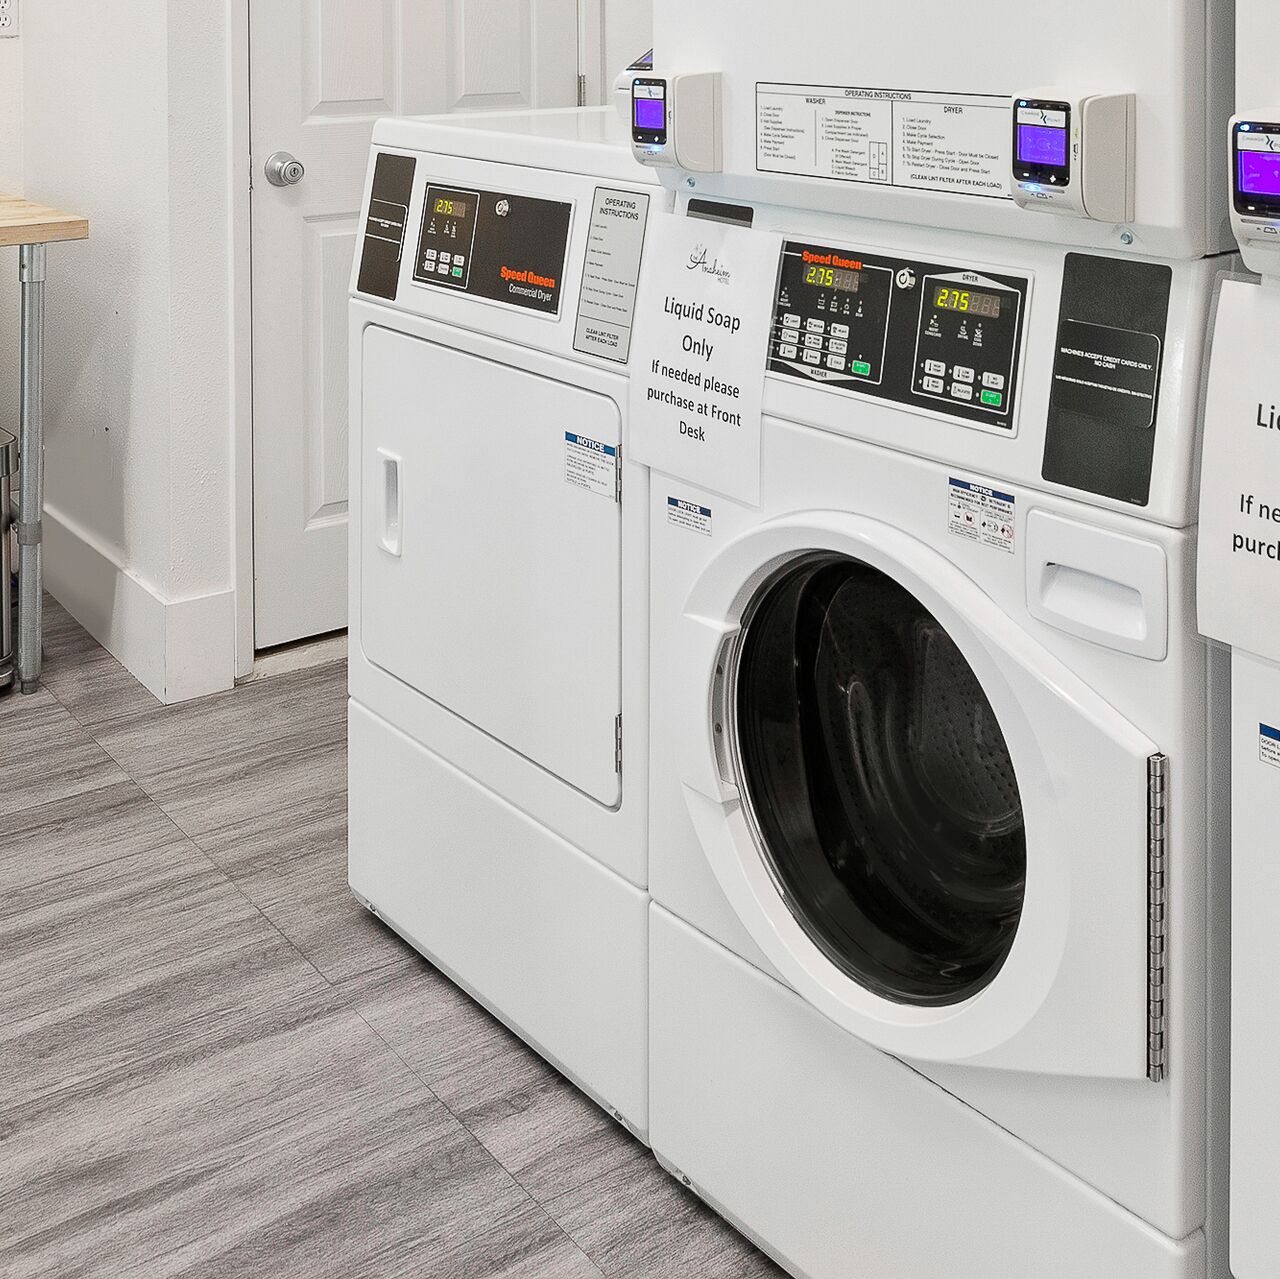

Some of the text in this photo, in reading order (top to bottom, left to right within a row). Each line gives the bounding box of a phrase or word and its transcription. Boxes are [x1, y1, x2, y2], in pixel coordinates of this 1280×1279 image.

[874, 92, 912, 100] INSTRUCTIONS
[605, 198, 636, 210] OPERATING
[600, 207, 639, 221] INSTRUCTIONS
[686, 248, 731, 278] Anaheim
[802, 251, 862, 270] Speed Queen
[500, 266, 555, 288] Speed Queen
[806, 267, 833, 286] 2.75
[962, 274, 978, 282] DRYER
[509, 283, 552, 302] Commercial Dryer
[937, 289, 969, 310] 2.75
[664, 296, 740, 334] Liquid Soap
[682, 335, 714, 362] Only
[652, 360, 739, 398] If needed please
[810, 369, 827, 378] WASHER
[647, 388, 741, 427] purchase at Front
[680, 420, 705, 442] Desk
[576, 435, 605, 452] NOTICE
[1240, 494, 1254, 514] If
